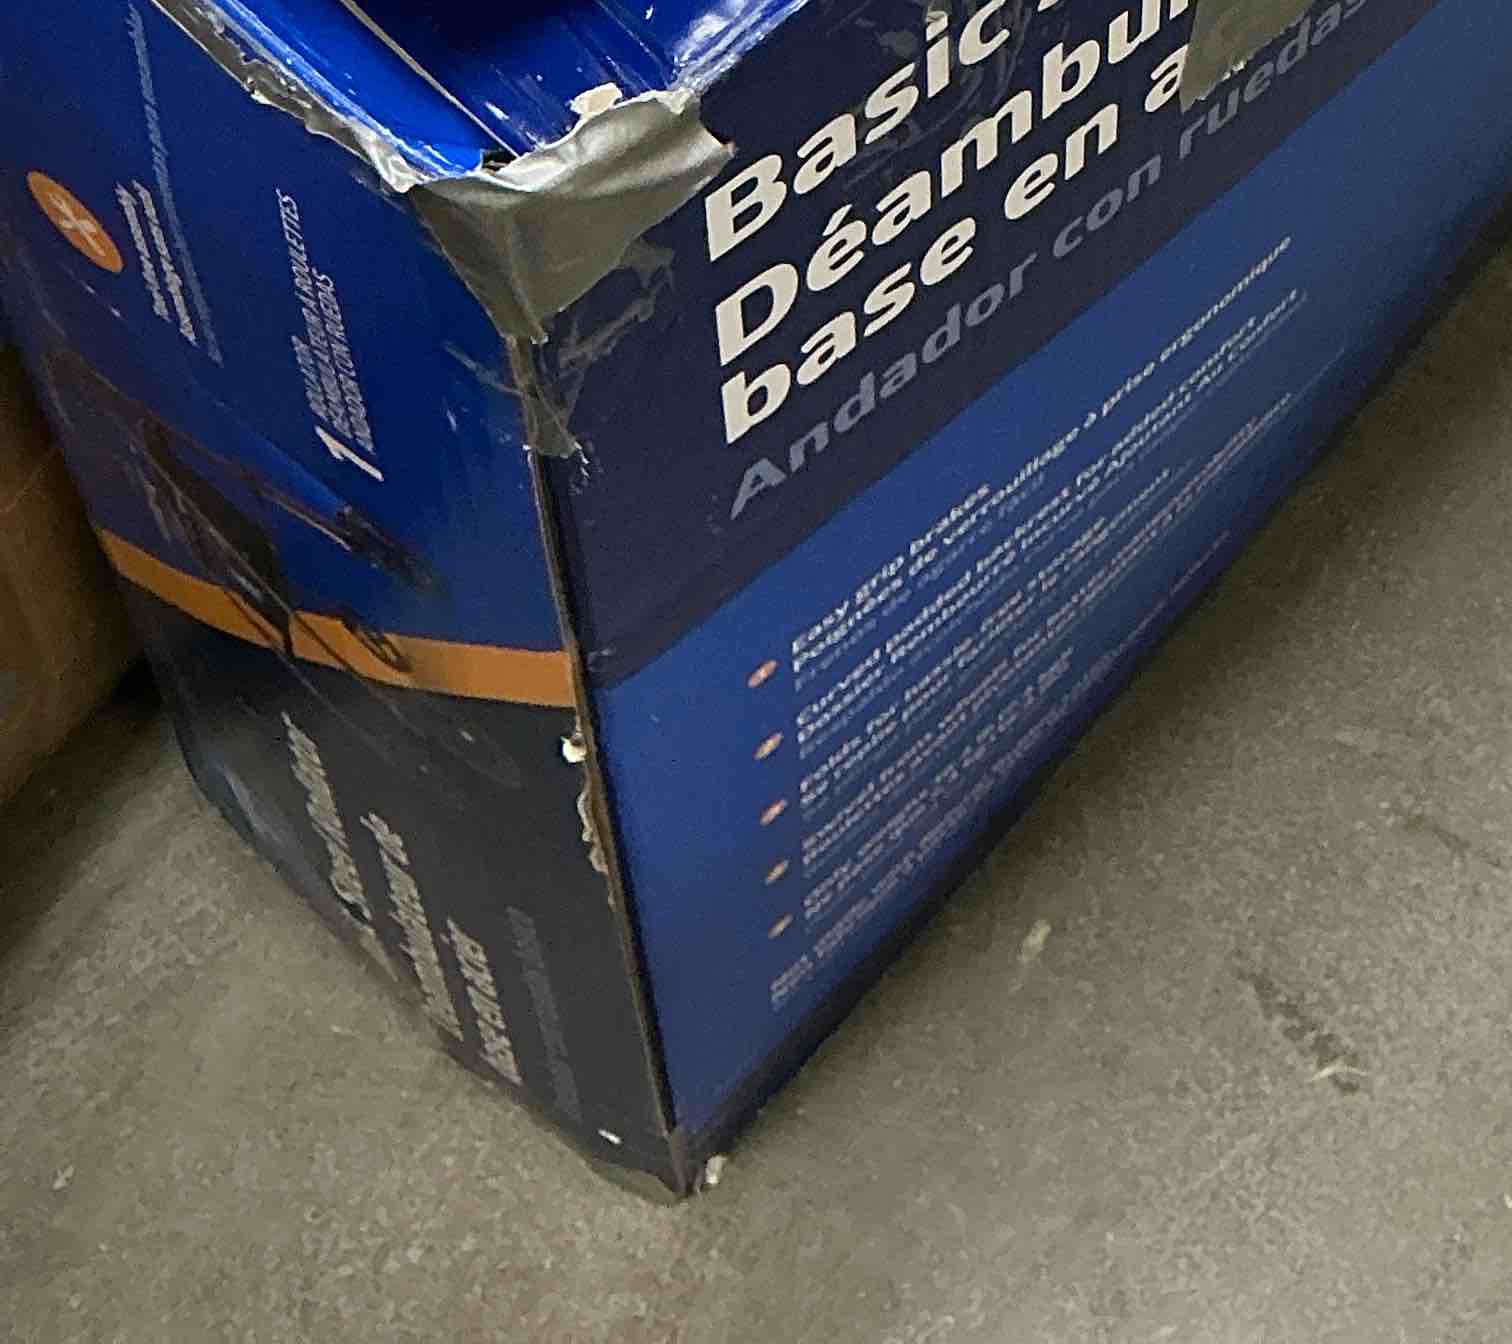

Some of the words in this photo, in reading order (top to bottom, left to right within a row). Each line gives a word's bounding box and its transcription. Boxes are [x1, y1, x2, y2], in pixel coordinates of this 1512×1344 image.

[722, 217, 978, 446] base
[1004, 114, 1119, 226] en
[728, 244, 1041, 520] Andador
[1052, 144, 1163, 257] con
[314, 424, 385, 482] 1
[910, 476, 989, 559] brakes
